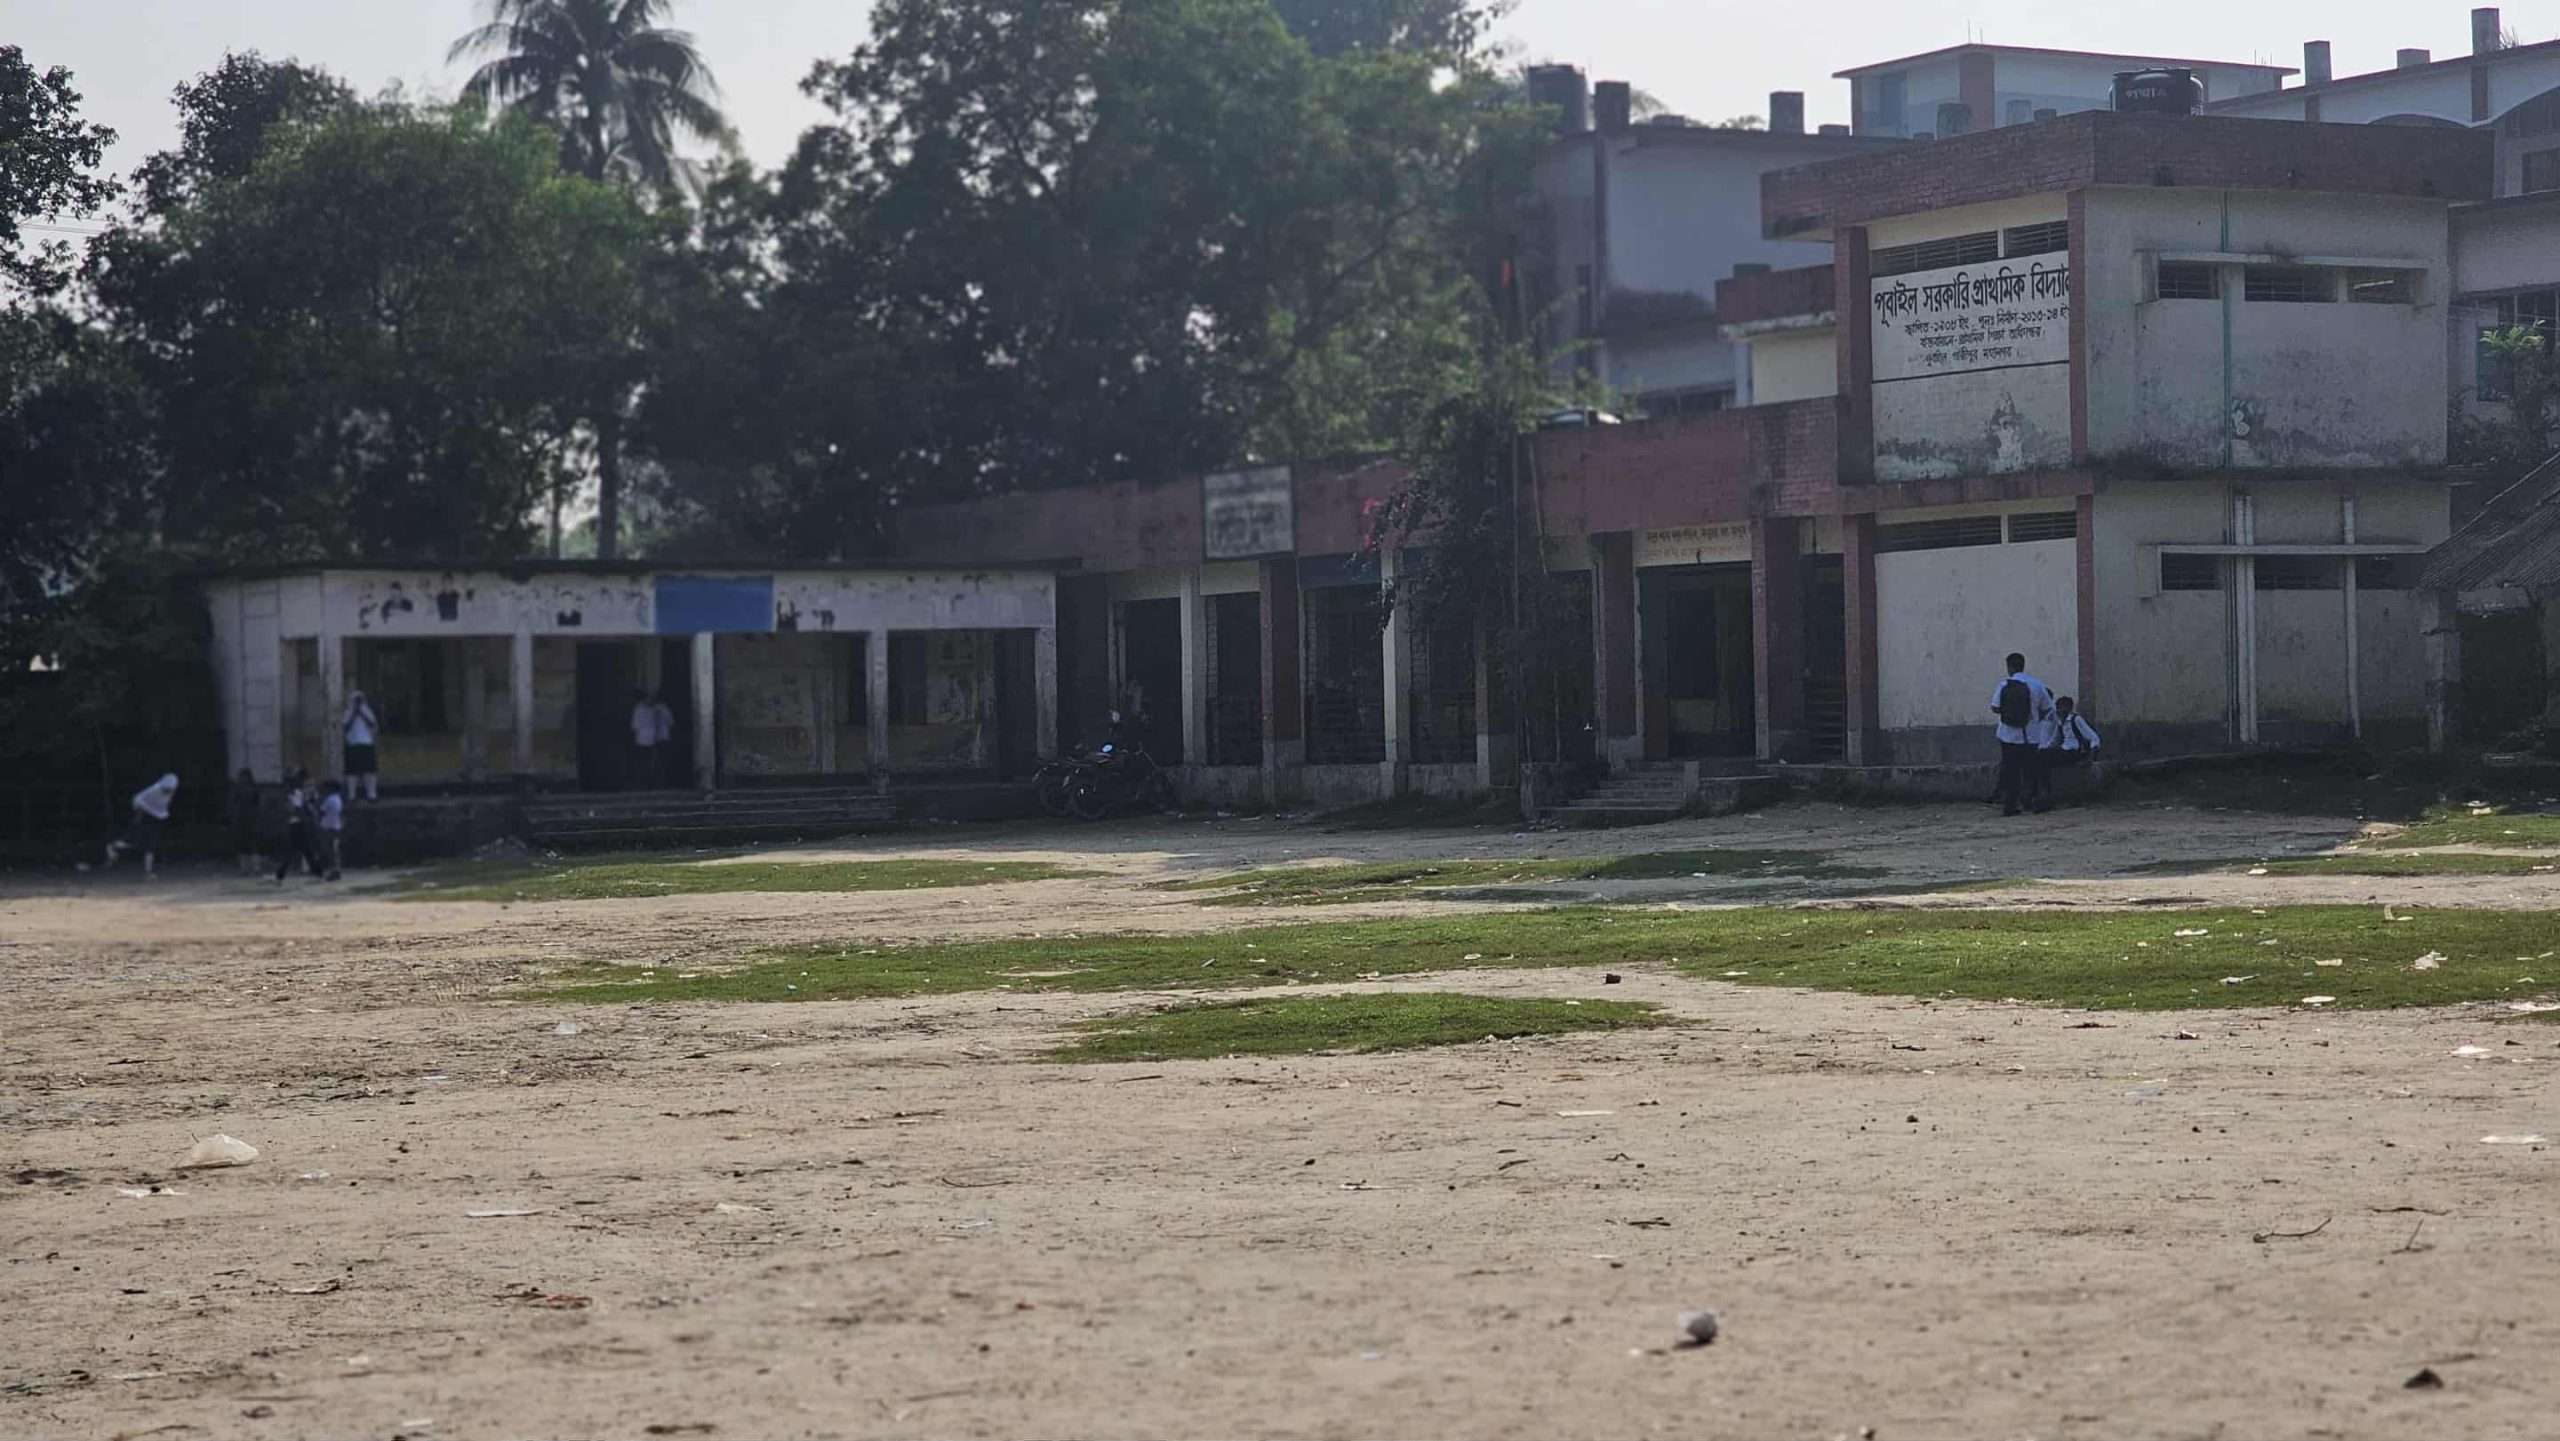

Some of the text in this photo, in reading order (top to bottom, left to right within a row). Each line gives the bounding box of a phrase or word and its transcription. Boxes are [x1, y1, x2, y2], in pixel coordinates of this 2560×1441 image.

[1874, 280, 1918, 328] পূবাইল
[1922, 271, 1970, 313] সরকারি
[1971, 266, 2026, 306] প্রাথমিক
